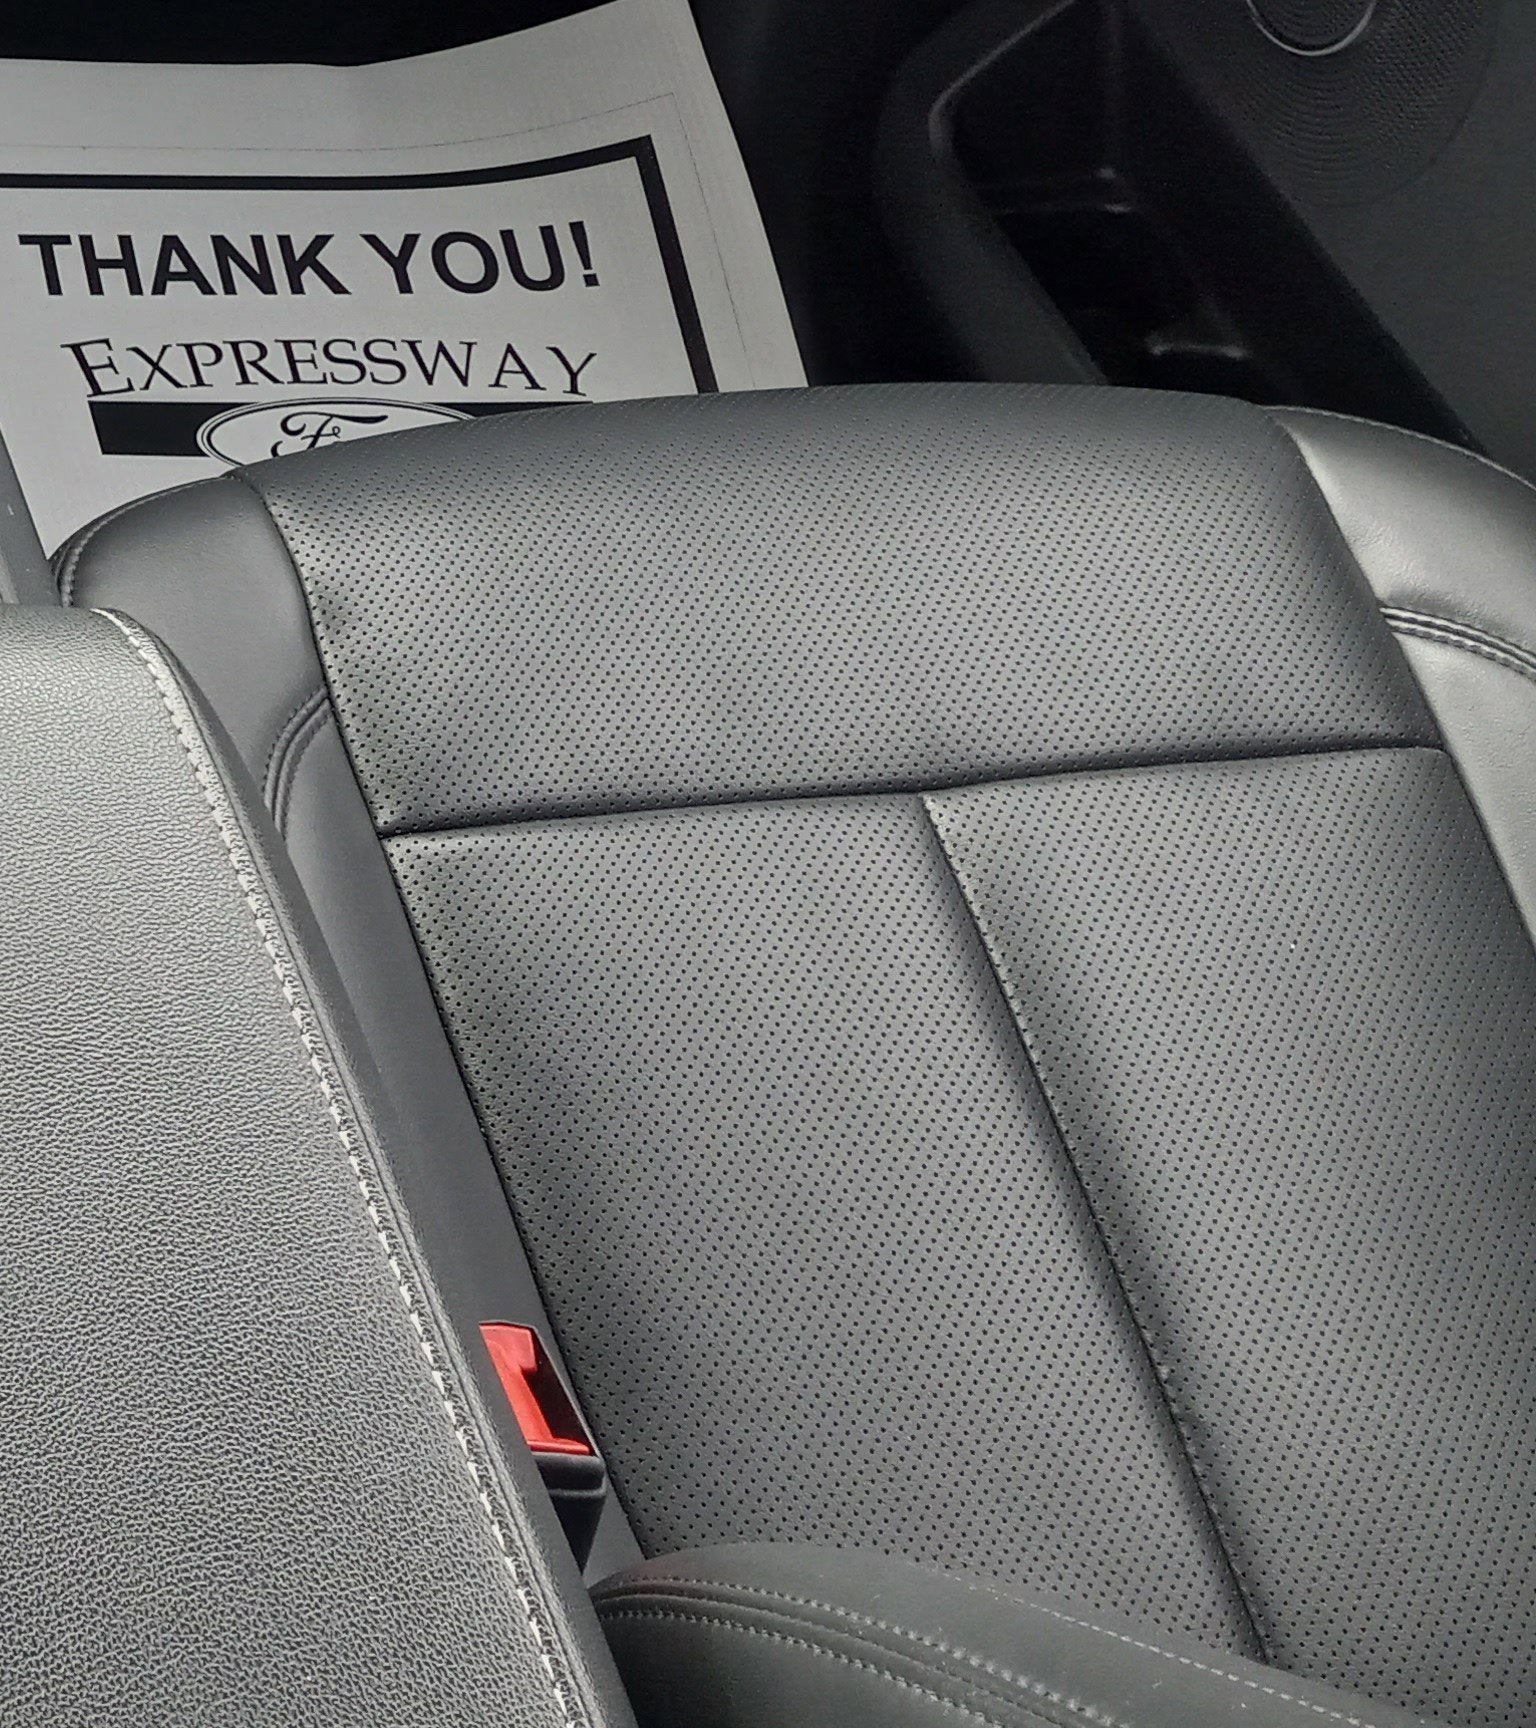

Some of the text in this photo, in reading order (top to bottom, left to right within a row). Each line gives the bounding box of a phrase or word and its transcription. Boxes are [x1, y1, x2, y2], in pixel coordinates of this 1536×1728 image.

[18, 220, 601, 296] THANK YOU!
[59, 337, 598, 398] EXPRESSWAY
